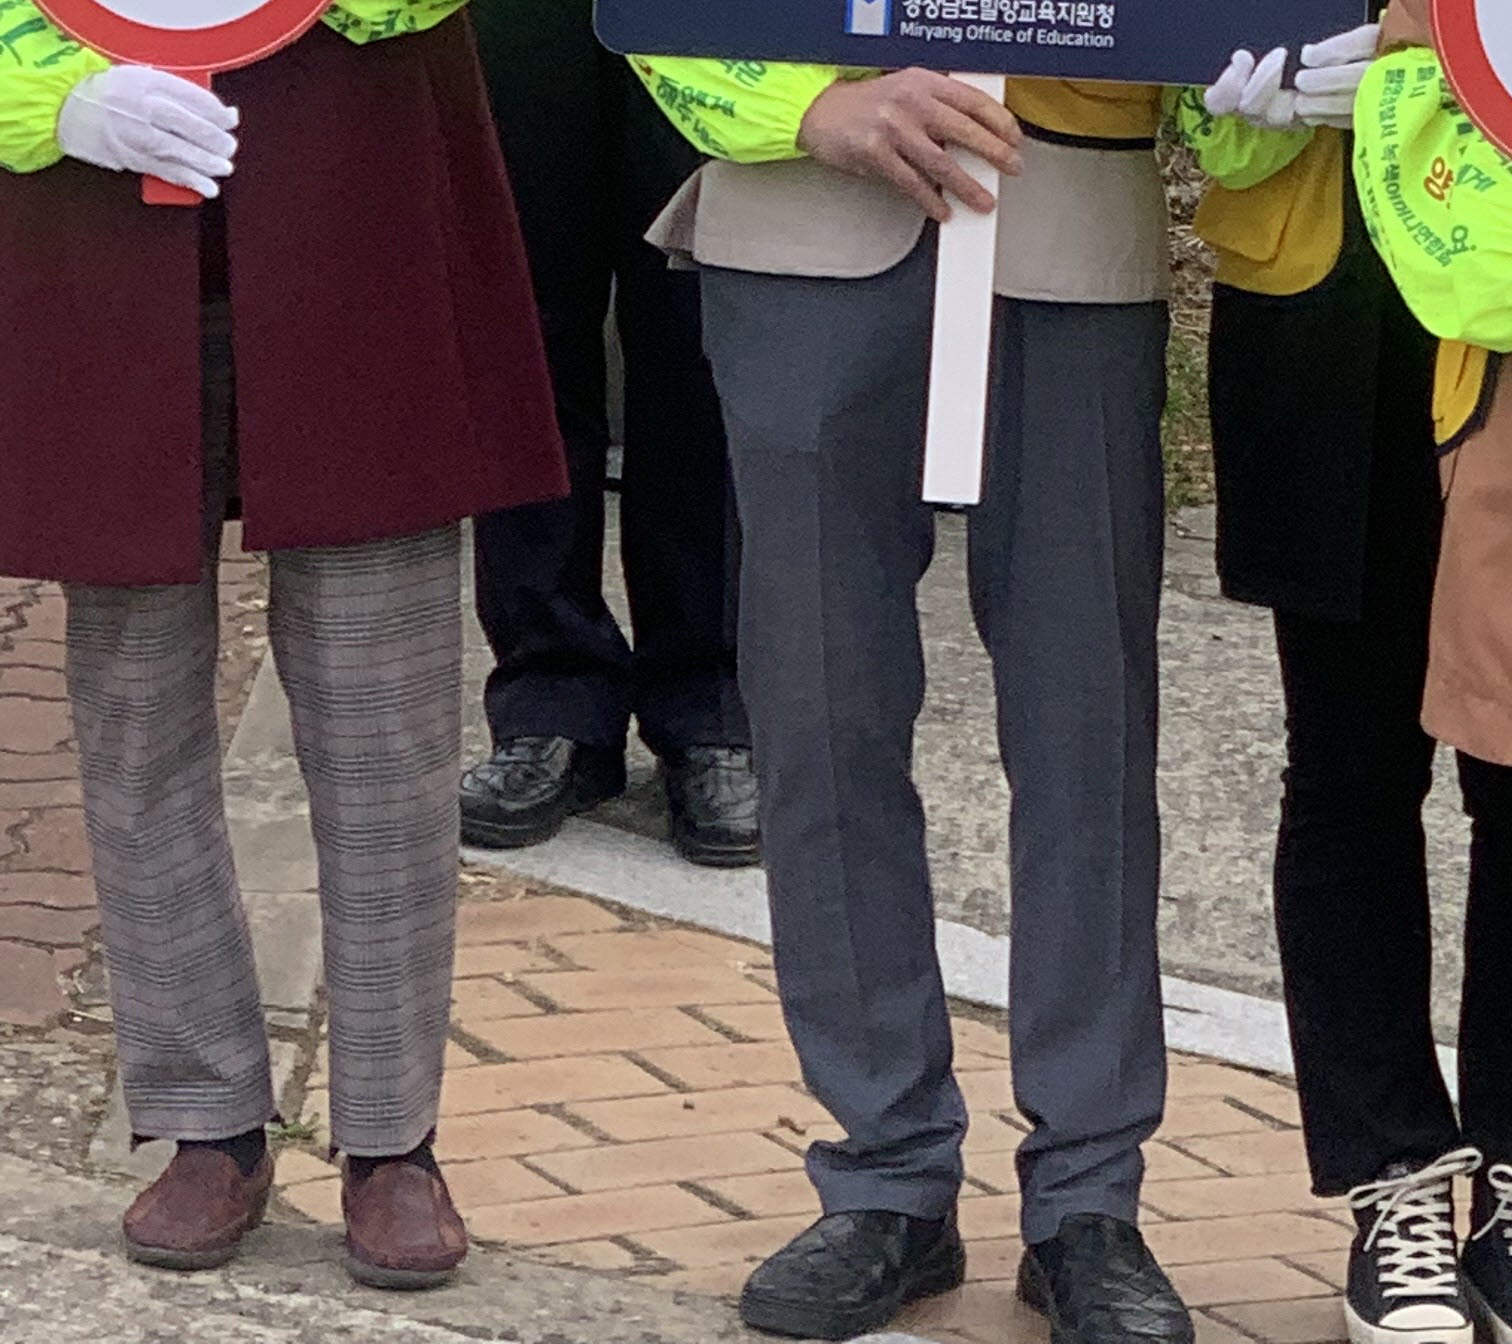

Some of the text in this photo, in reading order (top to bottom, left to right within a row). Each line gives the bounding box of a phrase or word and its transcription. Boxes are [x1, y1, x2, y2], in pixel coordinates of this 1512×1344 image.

[900, 21, 1115, 49] Miryang Office of Education
